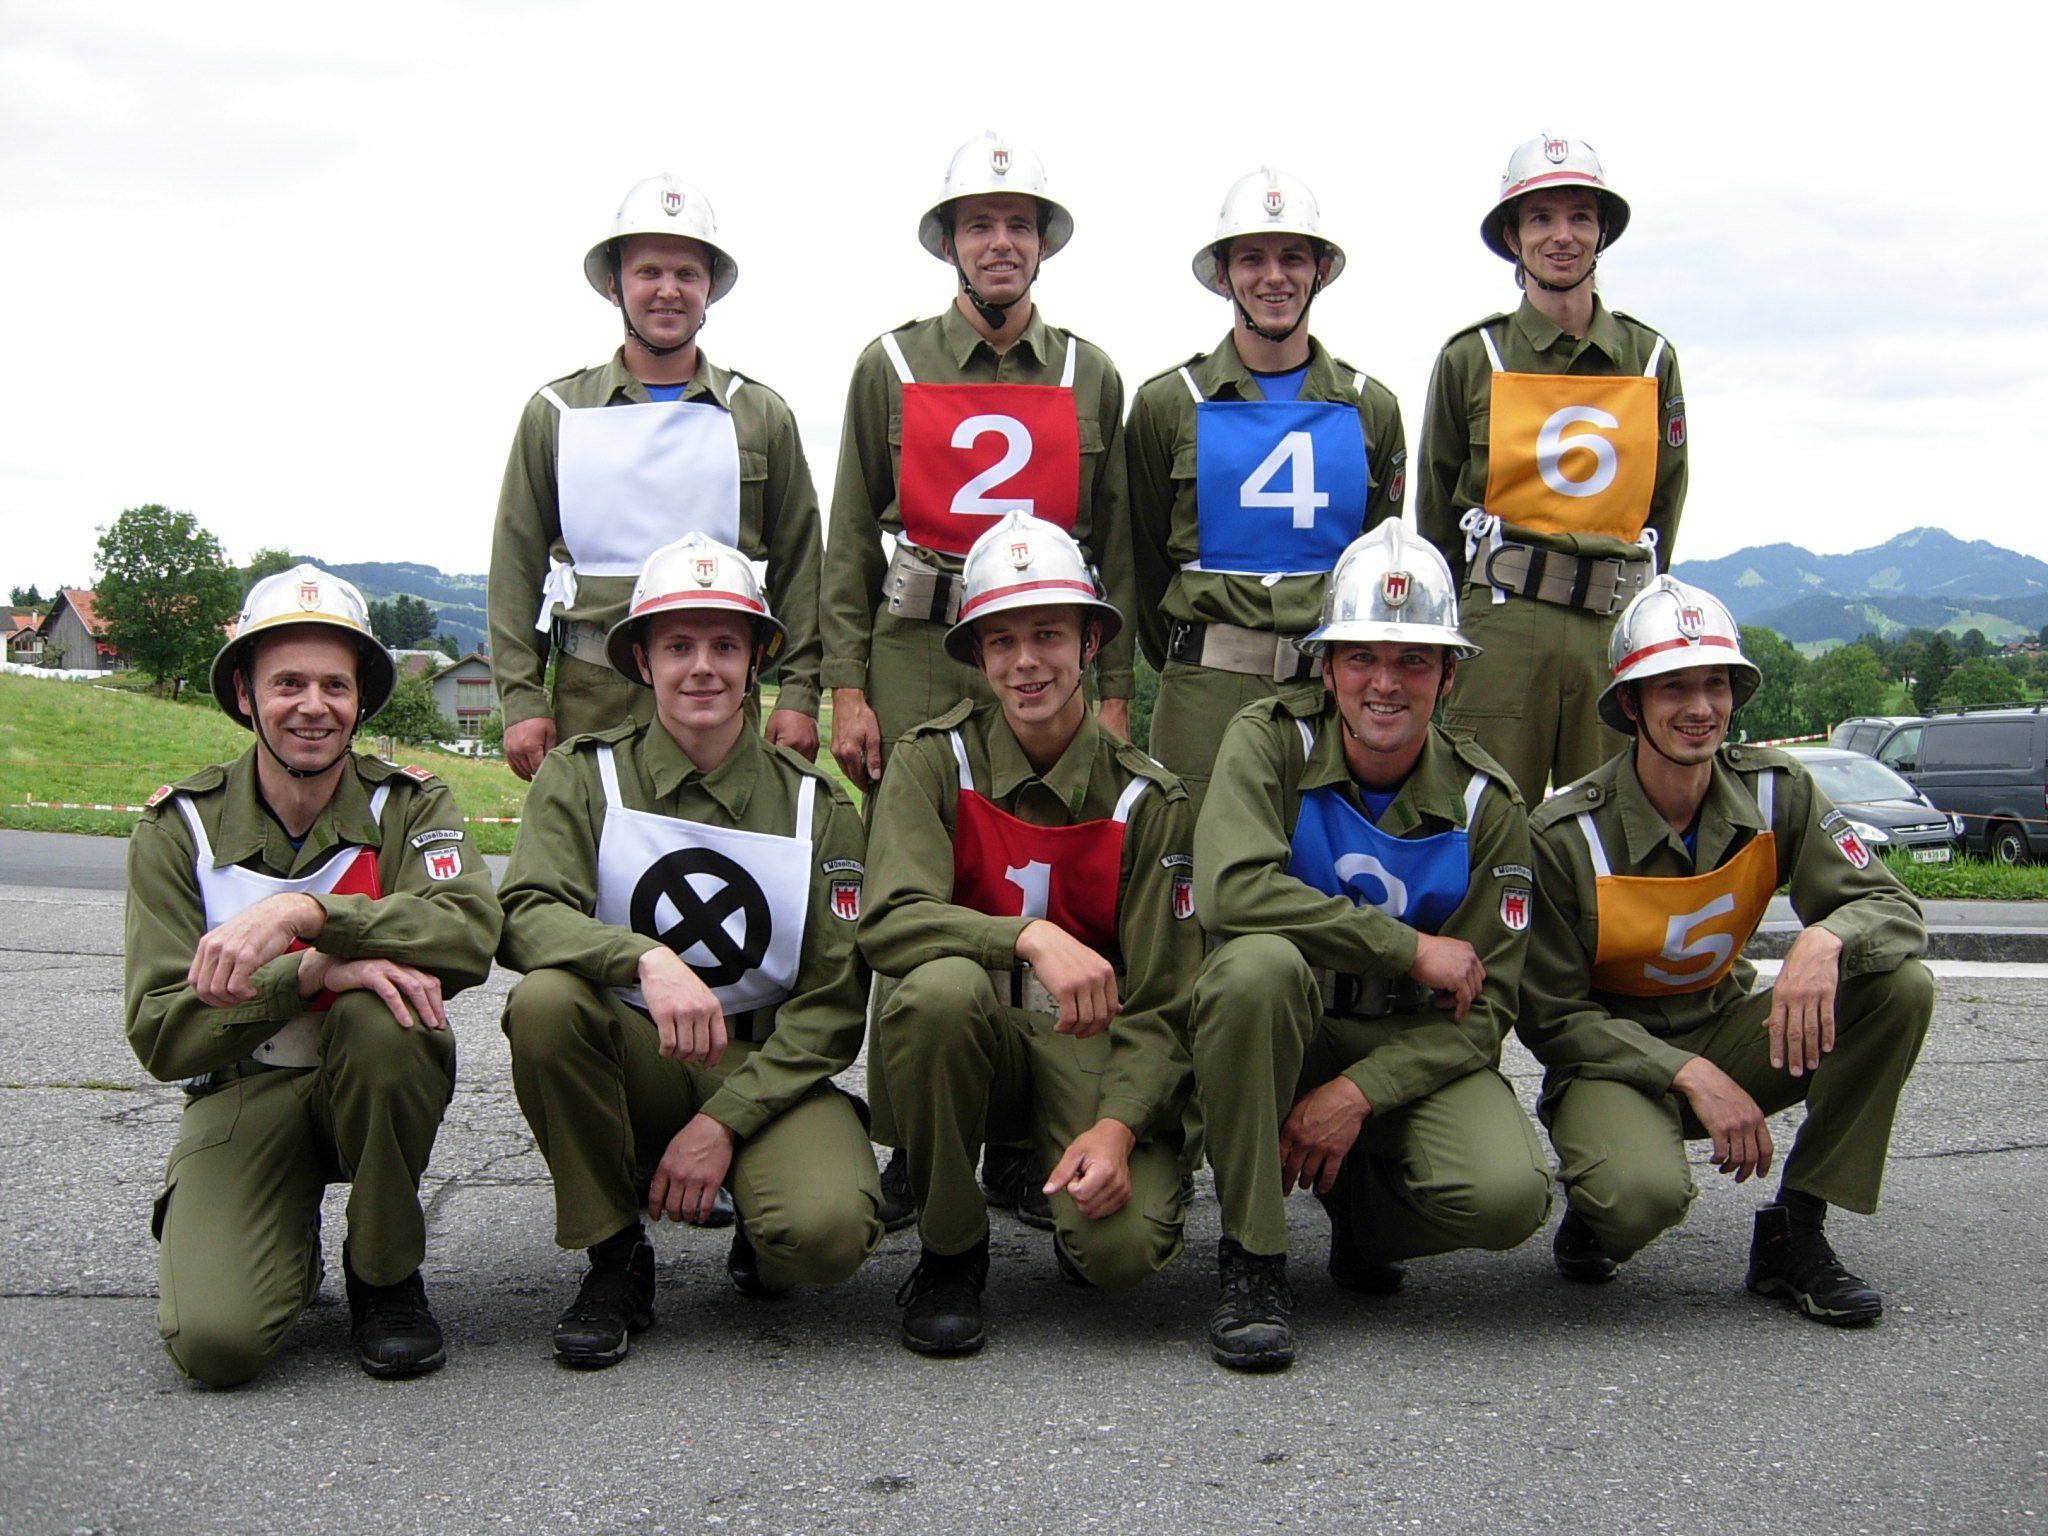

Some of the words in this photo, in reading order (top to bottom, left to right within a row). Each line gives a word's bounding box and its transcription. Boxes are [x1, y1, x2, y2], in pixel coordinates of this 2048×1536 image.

[950, 414, 1034, 516] 2
[1240, 431, 1329, 529] 4
[1536, 405, 1619, 497] 6
[1004, 859, 1051, 920] 1
[1643, 893, 1735, 986] 5
